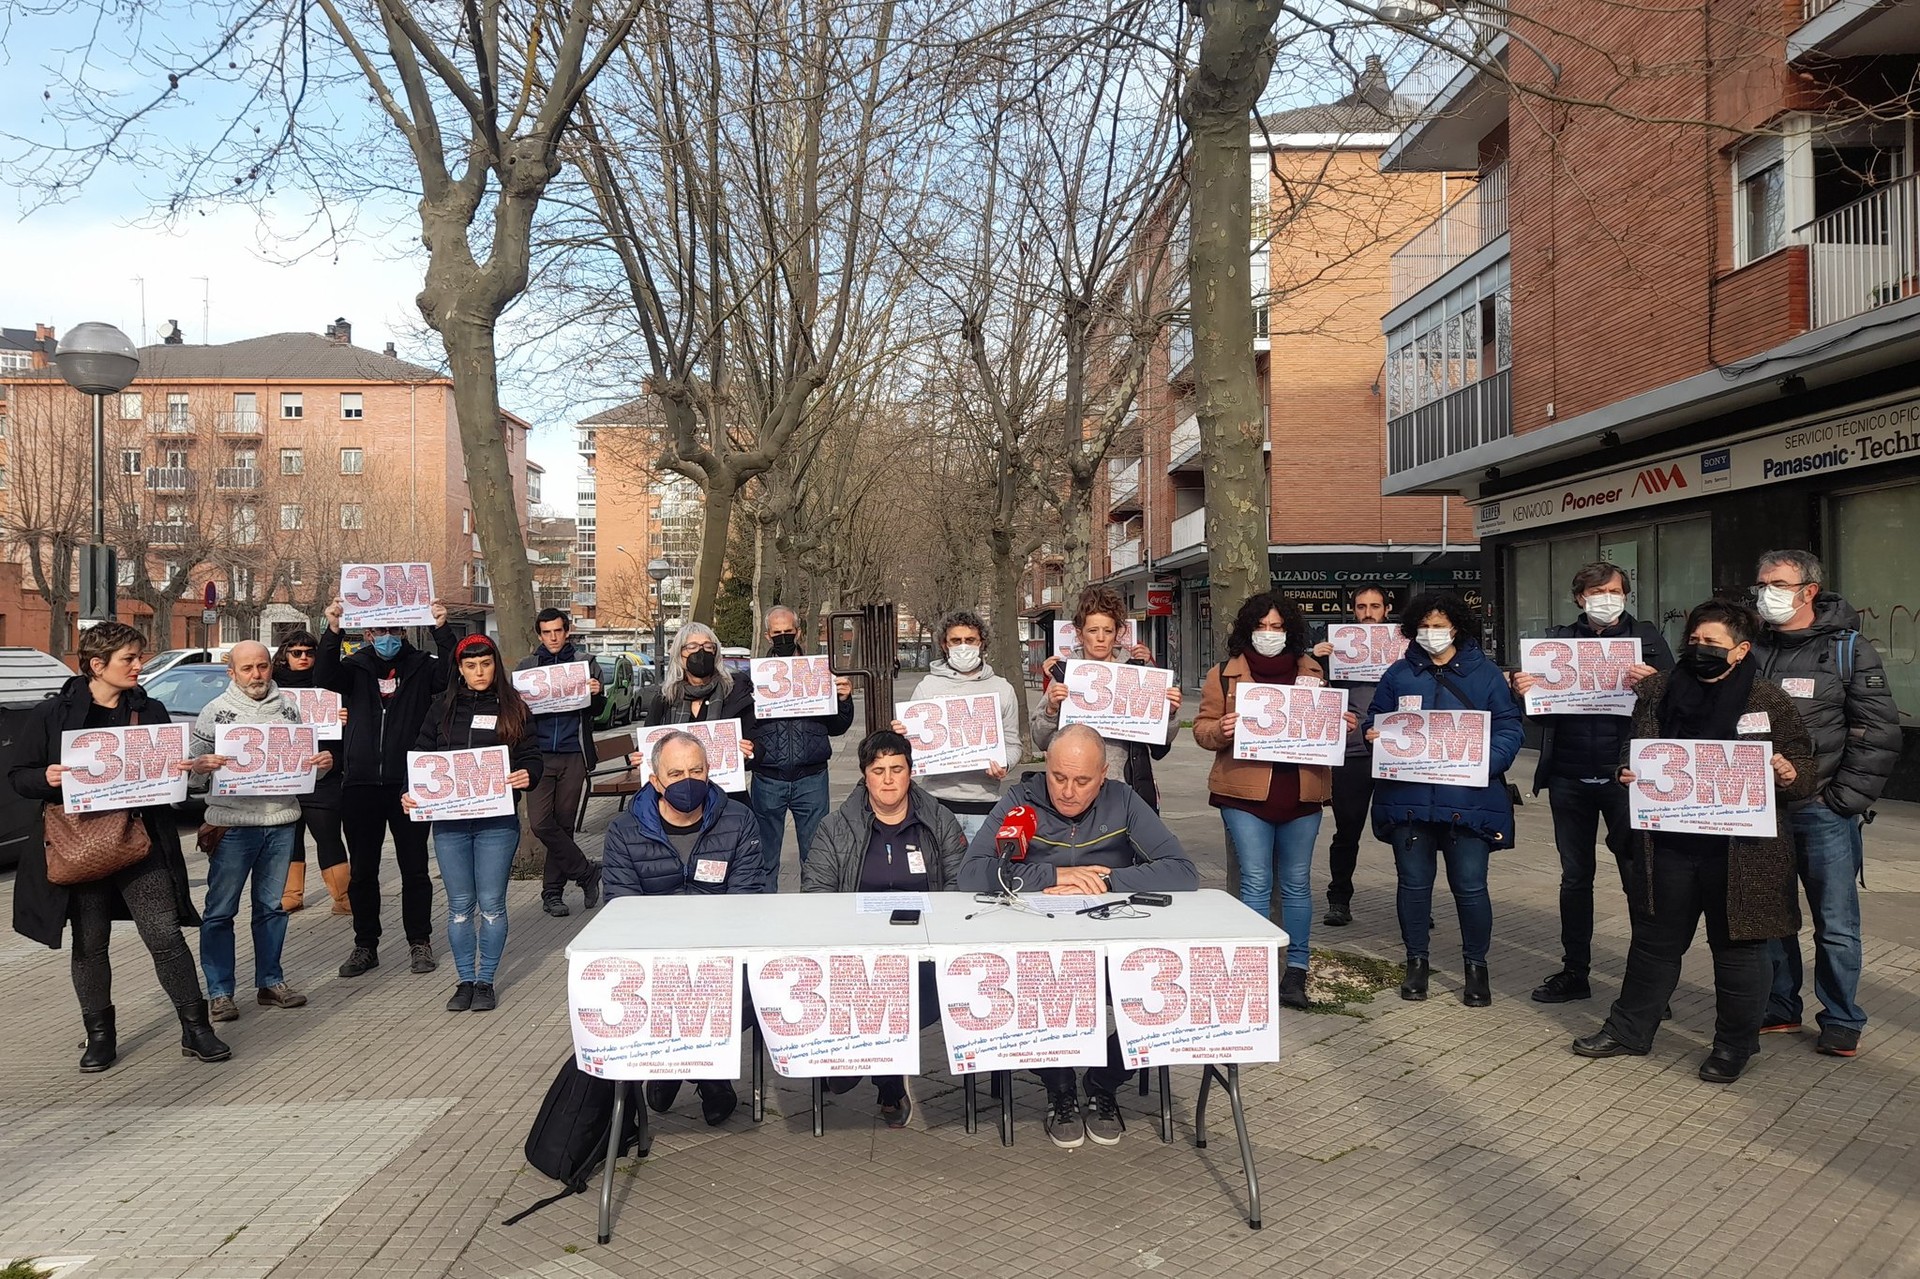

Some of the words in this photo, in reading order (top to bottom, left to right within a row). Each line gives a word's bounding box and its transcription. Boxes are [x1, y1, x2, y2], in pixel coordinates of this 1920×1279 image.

[1785, 427, 1834, 449] SERVICIO
[1836, 413, 1886, 437] TÉCNICO
[1703, 455, 1727, 468] SONY
[1763, 444, 1849, 480] Panasonic
[1512, 500, 1553, 521] KENWOOD
[1561, 488, 1623, 512] Pioneer
[1600, 549, 1613, 561] SE
[345, 565, 430, 606] 3M
[1269, 571, 1328, 581] ALZADOS
[1334, 571, 1413, 581] Gomez
[1334, 626, 1410, 664] 3M
[519, 664, 586, 701] 3M
[757, 658, 832, 698] 3M
[1529, 641, 1635, 690] 3M
[379, 680, 395, 689] 3M
[1070, 663, 1167, 720] 3M
[1399, 696, 1421, 707] 3M
[1783, 678, 1814, 692] 3M
[473, 715, 495, 725] 3M
[904, 696, 998, 751] 3M
[1242, 687, 1342, 742] 3M
[1740, 712, 1769, 728] 3M
[71, 726, 183, 784] 3M
[224, 727, 313, 772] 3M
[1381, 713, 1484, 762] 3M
[414, 750, 506, 799] 3M
[1637, 743, 1766, 806] 3M
[698, 860, 727, 877] 3M
[578, 956, 733, 1038] 3M
[760, 955, 909, 1036] 3M
[947, 950, 1096, 1030] 3M
[1120, 947, 1268, 1026] 3M
[650, 1048, 662, 1058] por
[665, 1046, 670, 1054] el
[830, 1046, 842, 1055] por
[845, 1043, 850, 1051] el
[1019, 1040, 1030, 1049] por
[1033, 1037, 1038, 1045] el
[1192, 1035, 1203, 1044] por
